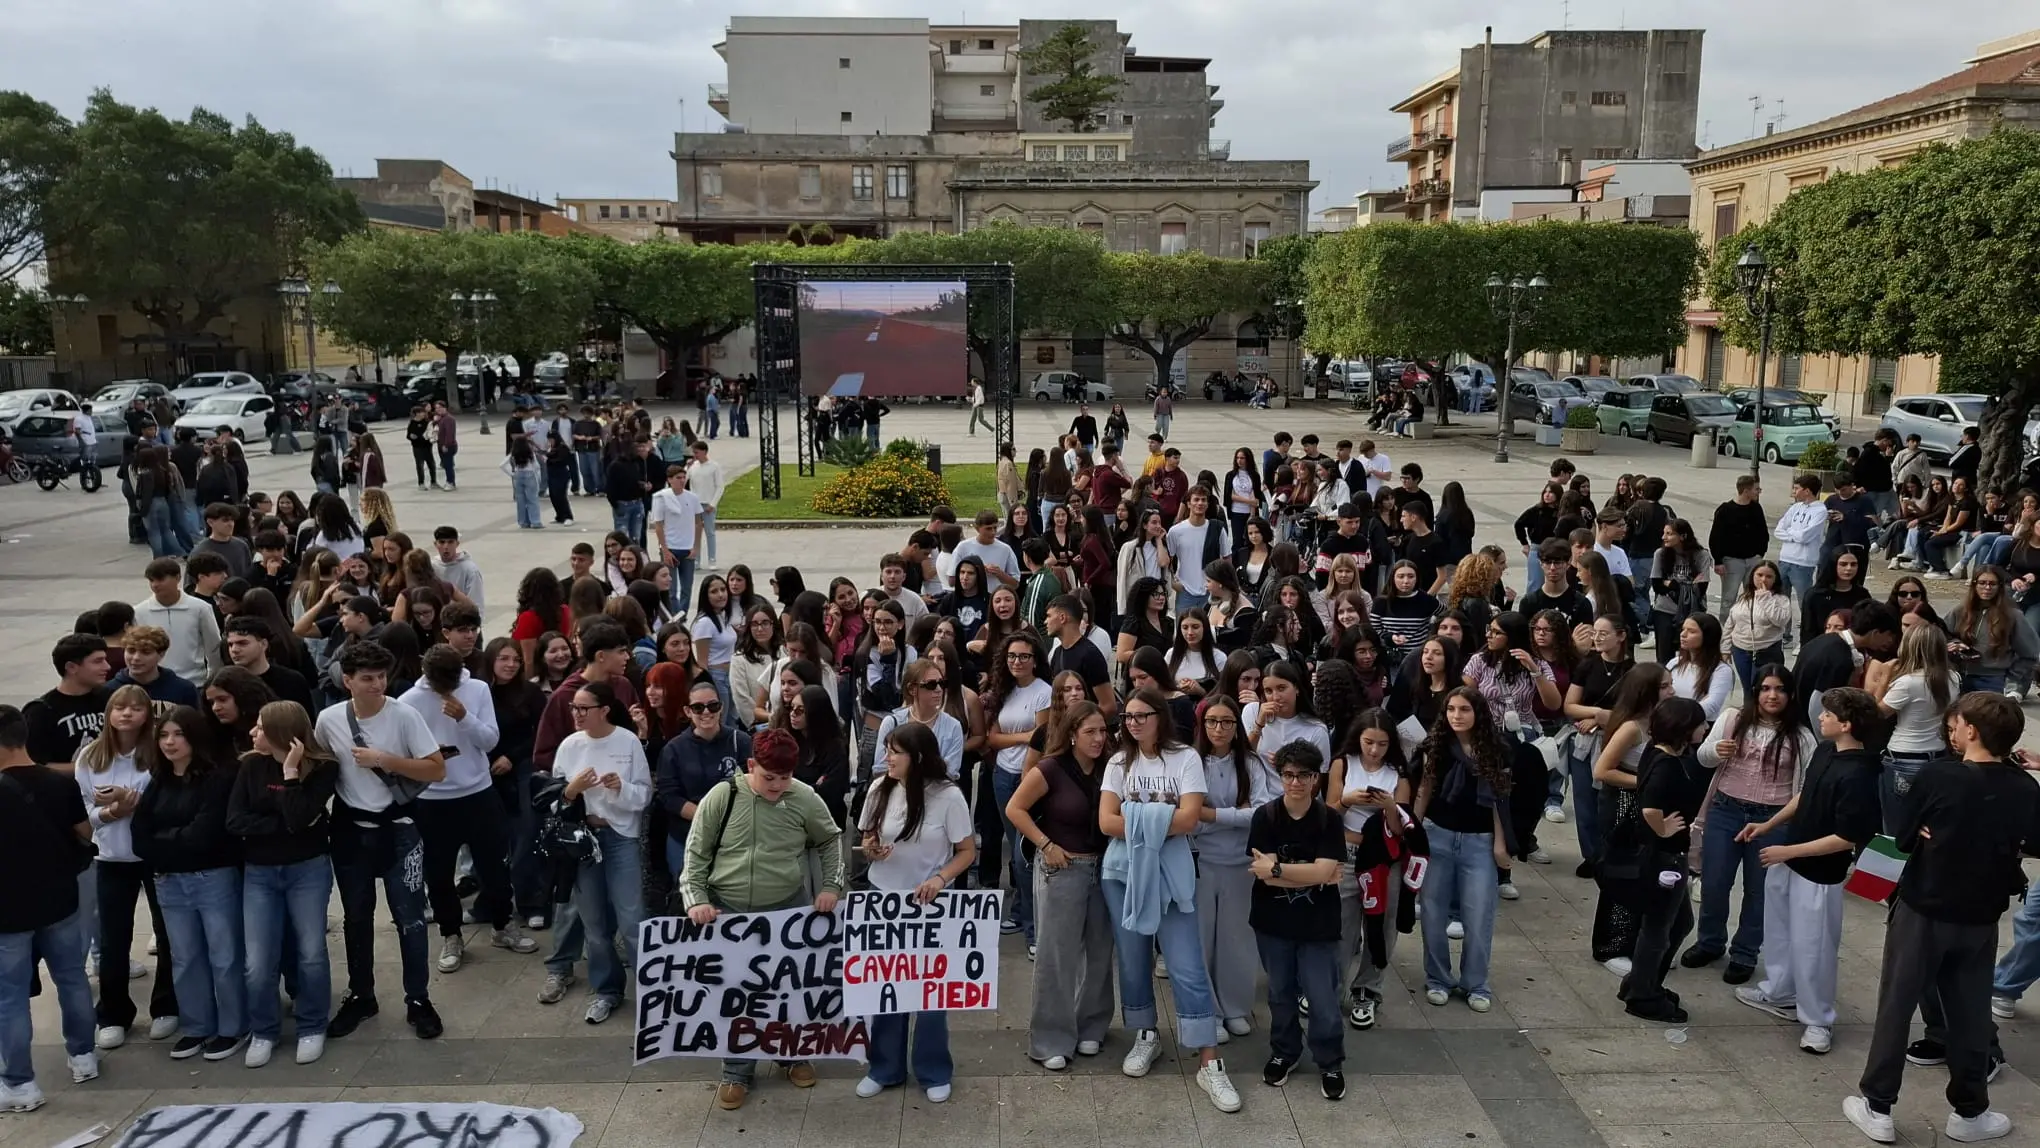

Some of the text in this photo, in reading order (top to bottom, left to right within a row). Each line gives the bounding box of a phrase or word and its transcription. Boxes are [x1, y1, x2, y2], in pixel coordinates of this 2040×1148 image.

[57, 711, 105, 738] Tupa
[1128, 775, 1180, 796] ANHATTAN
[845, 891, 1000, 921] PROSSIMA
[781, 910, 844, 950] CO
[958, 920, 977, 949] A
[638, 948, 843, 992] CHE SALE
[843, 950, 984, 985] CAVALLO O
[803, 988, 843, 1022] VO
[879, 980, 991, 1013] A PIEDI
[673, 1021, 718, 1053] LA
